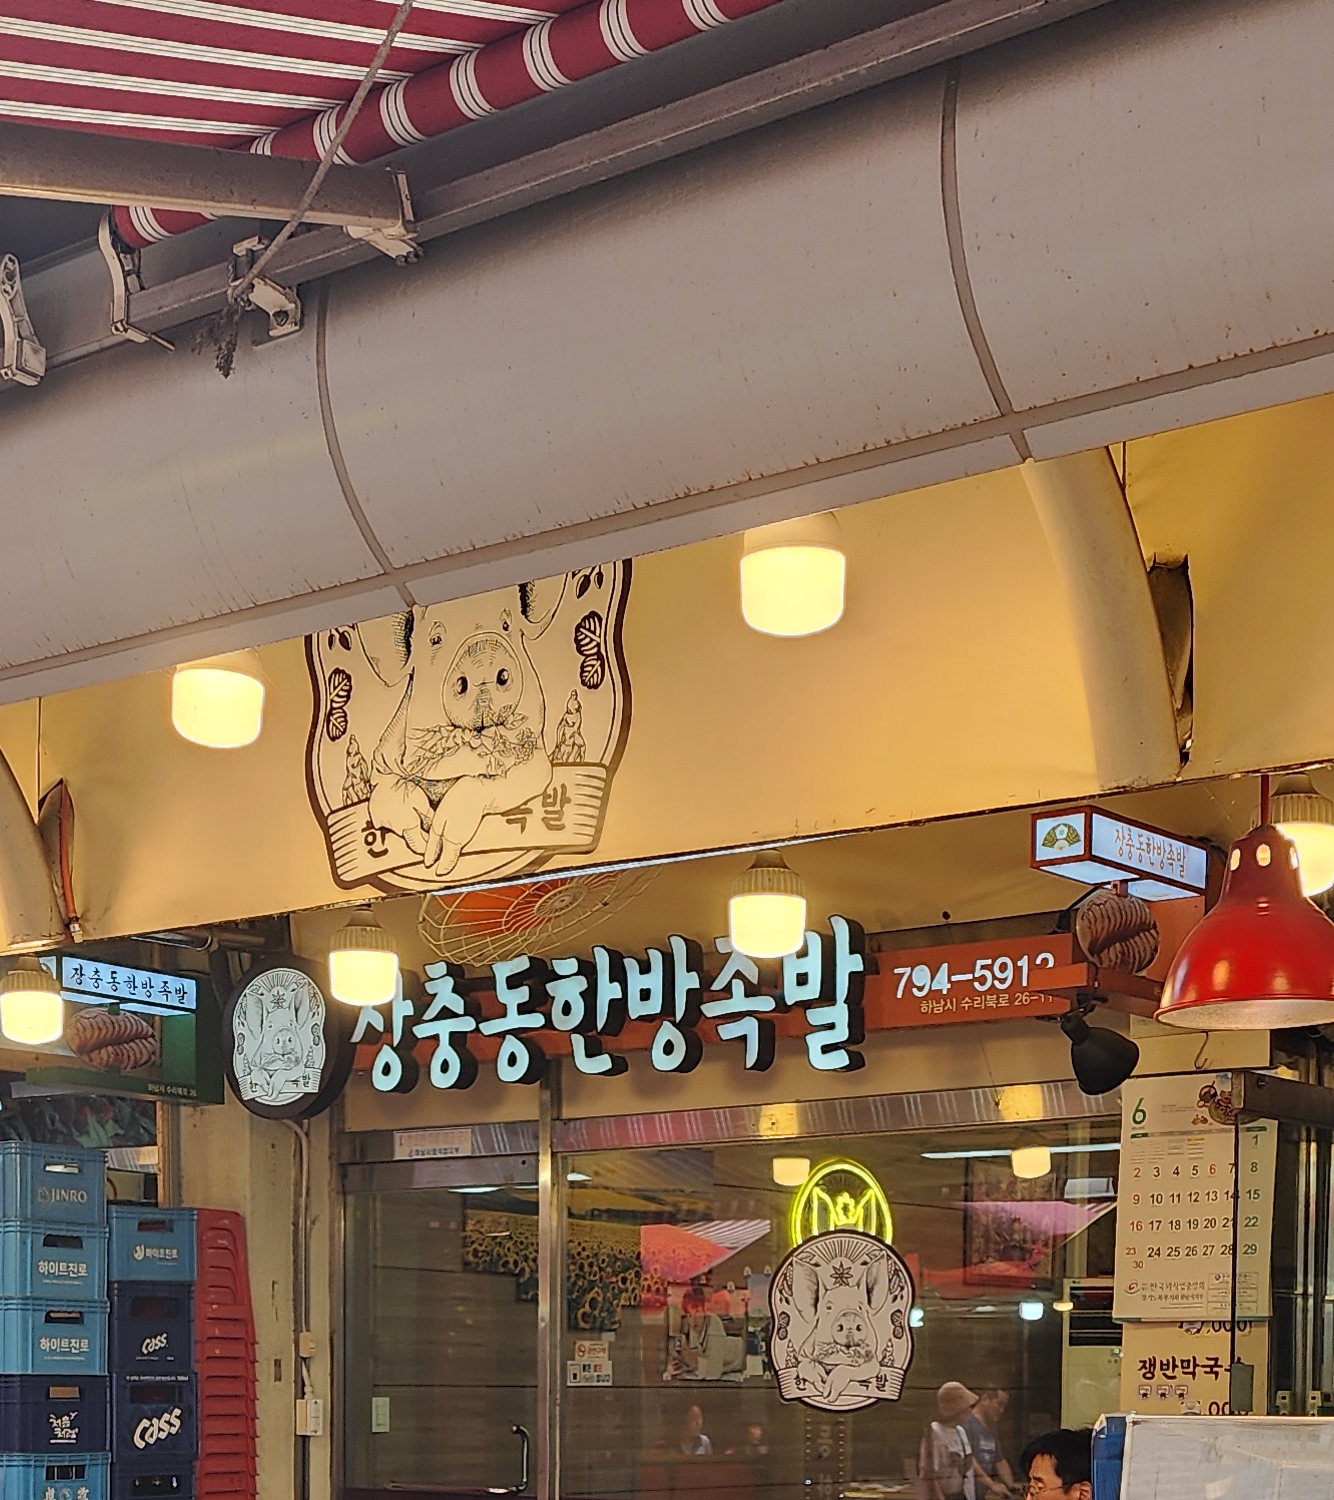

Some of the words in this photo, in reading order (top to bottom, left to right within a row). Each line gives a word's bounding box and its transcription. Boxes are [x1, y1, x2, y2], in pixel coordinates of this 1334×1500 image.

[1114, 824, 1188, 878] 장충동한방족발
[69, 963, 189, 1005] 장충동한방족발
[920, 997, 957, 1015] 하남시
[960, 993, 1011, 1012] 수리북로
[1132, 1097, 1147, 1125] 6
[1253, 1134, 1259, 1146] 1
[1134, 1167, 1141, 1178] 2
[1153, 1166, 1160, 1178] 3
[1172, 1165, 1180, 1177] 4
[1192, 1165, 1199, 1176] 5
[1209, 1163, 1217, 1175] 6
[1250, 1161, 1258, 1173] 8
[49, 1187, 88, 1205] JINRO
[1133, 1194, 1140, 1205] 9
[1150, 1193, 1163, 1205] 10
[1169, 1192, 1181, 1204] 11
[1187, 1192, 1200, 1203] 12
[1205, 1190, 1218, 1202] 13
[1246, 1189, 1261, 1200] 15
[1130, 1220, 1143, 1232] 16
[1148, 1220, 1162, 1231] 17
[1168, 1219, 1181, 1231] 18
[1186, 1219, 1199, 1230] 19
[1203, 1217, 1217, 1229] 20
[1244, 1216, 1259, 1228] 22
[145, 1247, 179, 1260] 하이트진로
[1126, 1247, 1137, 1256] 23
[1147, 1246, 1161, 1258] 24
[1166, 1246, 1181, 1258] 25
[1185, 1245, 1198, 1257] 26
[1202, 1245, 1215, 1256] 27
[1242, 1243, 1258, 1255] 29
[37, 1259, 89, 1278] 하이트진로
[1133, 1260, 1144, 1269] 30
[39, 1336, 90, 1354] 하이트진로
